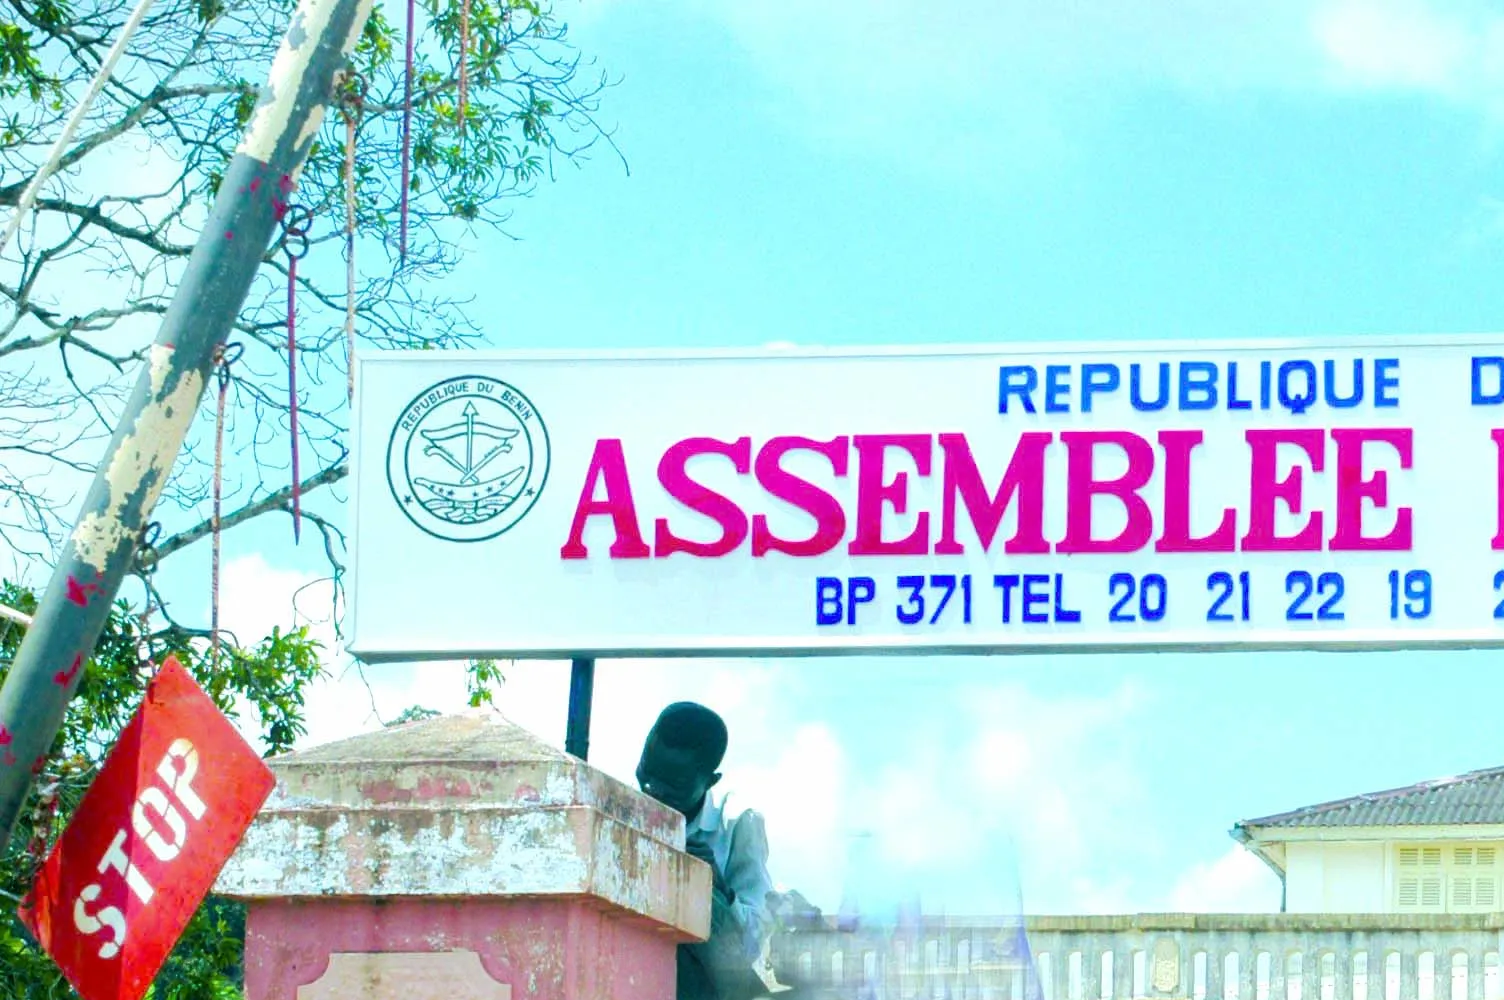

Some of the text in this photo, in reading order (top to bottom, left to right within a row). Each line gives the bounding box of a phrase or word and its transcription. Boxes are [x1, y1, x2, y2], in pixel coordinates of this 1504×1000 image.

[401, 381, 533, 431] REPUBLIQUE DU BENIN
[999, 358, 1400, 415] REPUBLIQUE
[560, 427, 1414, 560] ASSEMBLEE
[815, 576, 877, 626] BP
[896, 574, 972, 626] 371
[993, 572, 1082, 625] TEL
[1108, 572, 1168, 623] 20
[1206, 571, 1250, 622] 21
[1285, 570, 1345, 622] 22
[1388, 569, 1432, 620] 19
[73, 737, 208, 959] STOP
